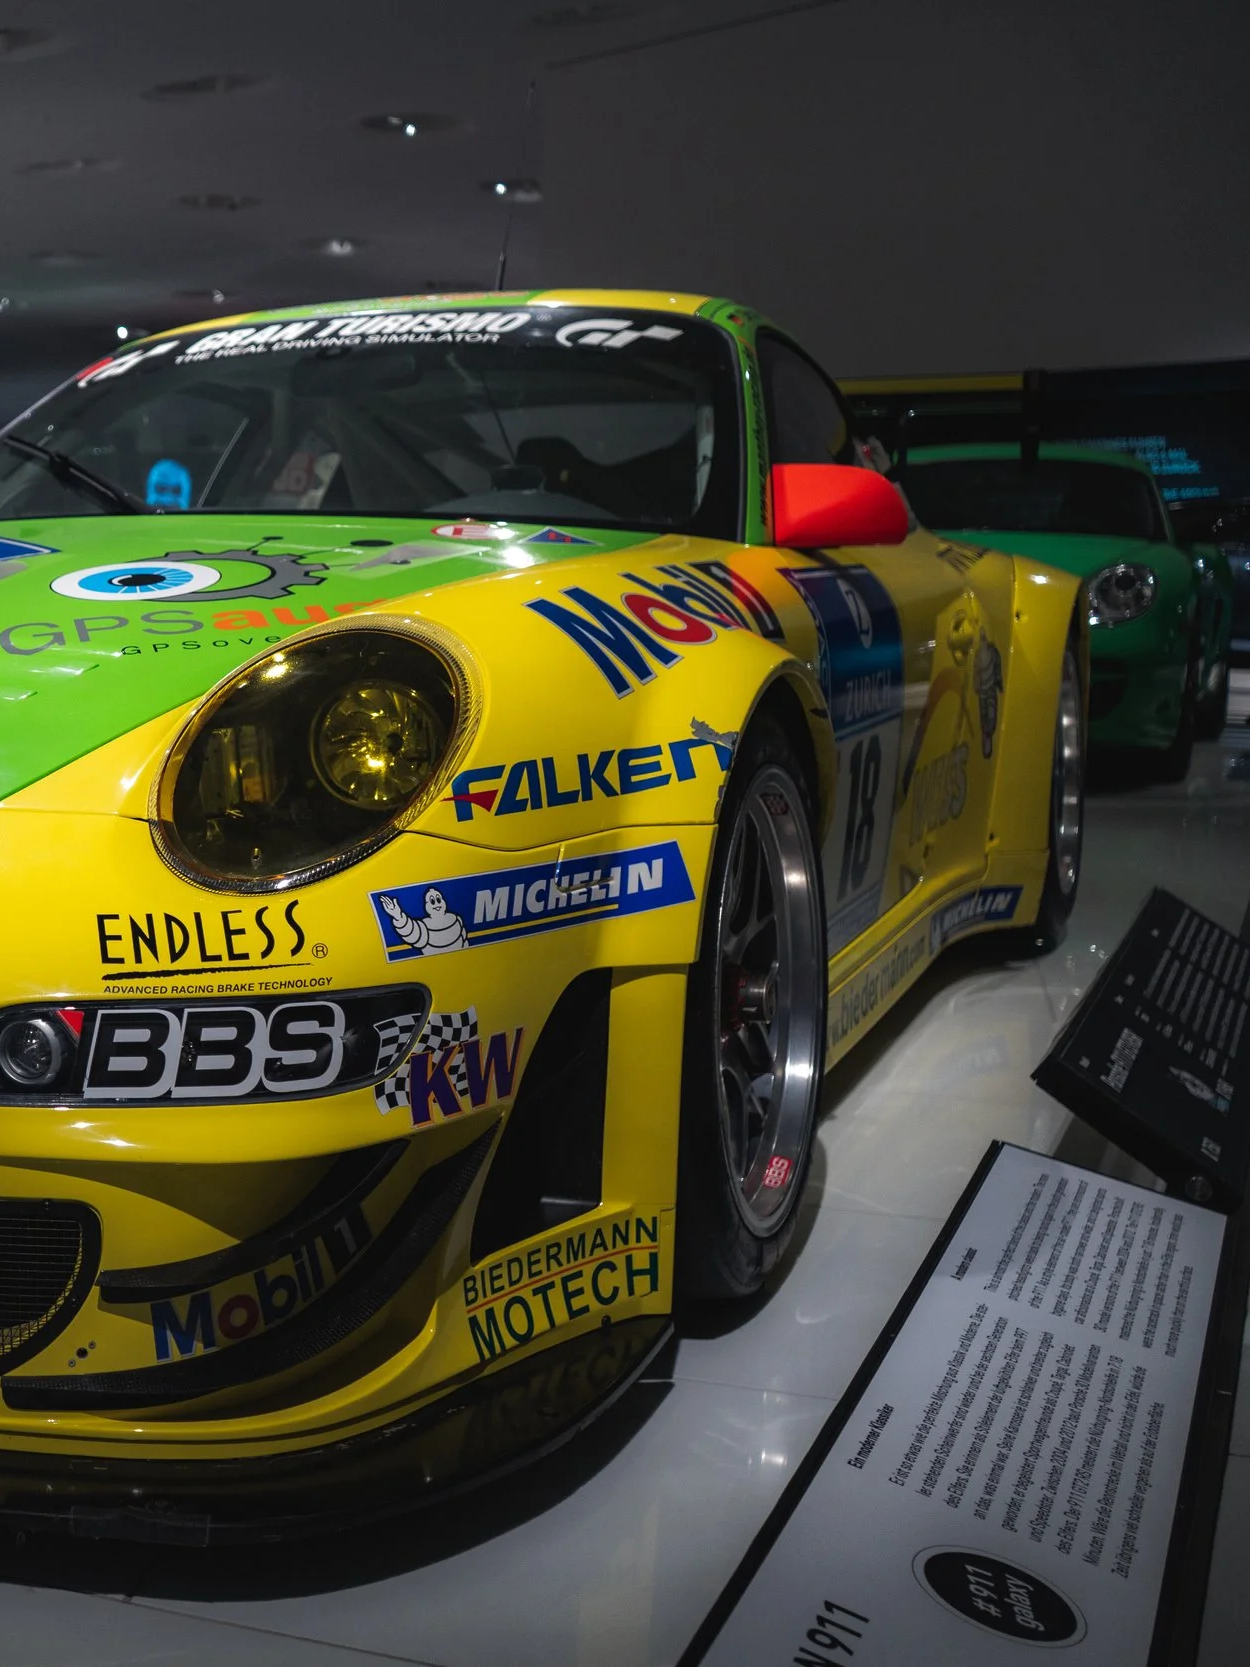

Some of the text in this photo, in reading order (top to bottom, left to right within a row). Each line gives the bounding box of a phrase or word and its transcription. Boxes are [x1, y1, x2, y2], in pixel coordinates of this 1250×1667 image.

[175, 332, 500, 365] THE REAL DRIVING SIMULATOR
[185, 312, 532, 355] GRAN TURISMO
[844, 667, 892, 722] ZURICH
[838, 734, 882, 902] 18
[473, 858, 664, 924] MICHELIN
[97, 900, 305, 964] ENDLESS
[104, 976, 333, 995] ADVANCED RACING BRAKE TECHNOLOGY
[84, 1001, 345, 1098] BBS
[409, 1025, 526, 1129] KW
[764, 1156, 790, 1188] BBS
[464, 1216, 659, 1306] BIEDERMANN
[151, 1237, 325, 1361] Mobil
[468, 1252, 659, 1363] MOTECH
[888, 1476, 905, 1486] Er
[1050, 1446, 1068, 1466] 2004
[1075, 1468, 1091, 1481] RS
[806, 1600, 870, 1656] 911
[1002, 1573, 1046, 1632] galaxy
